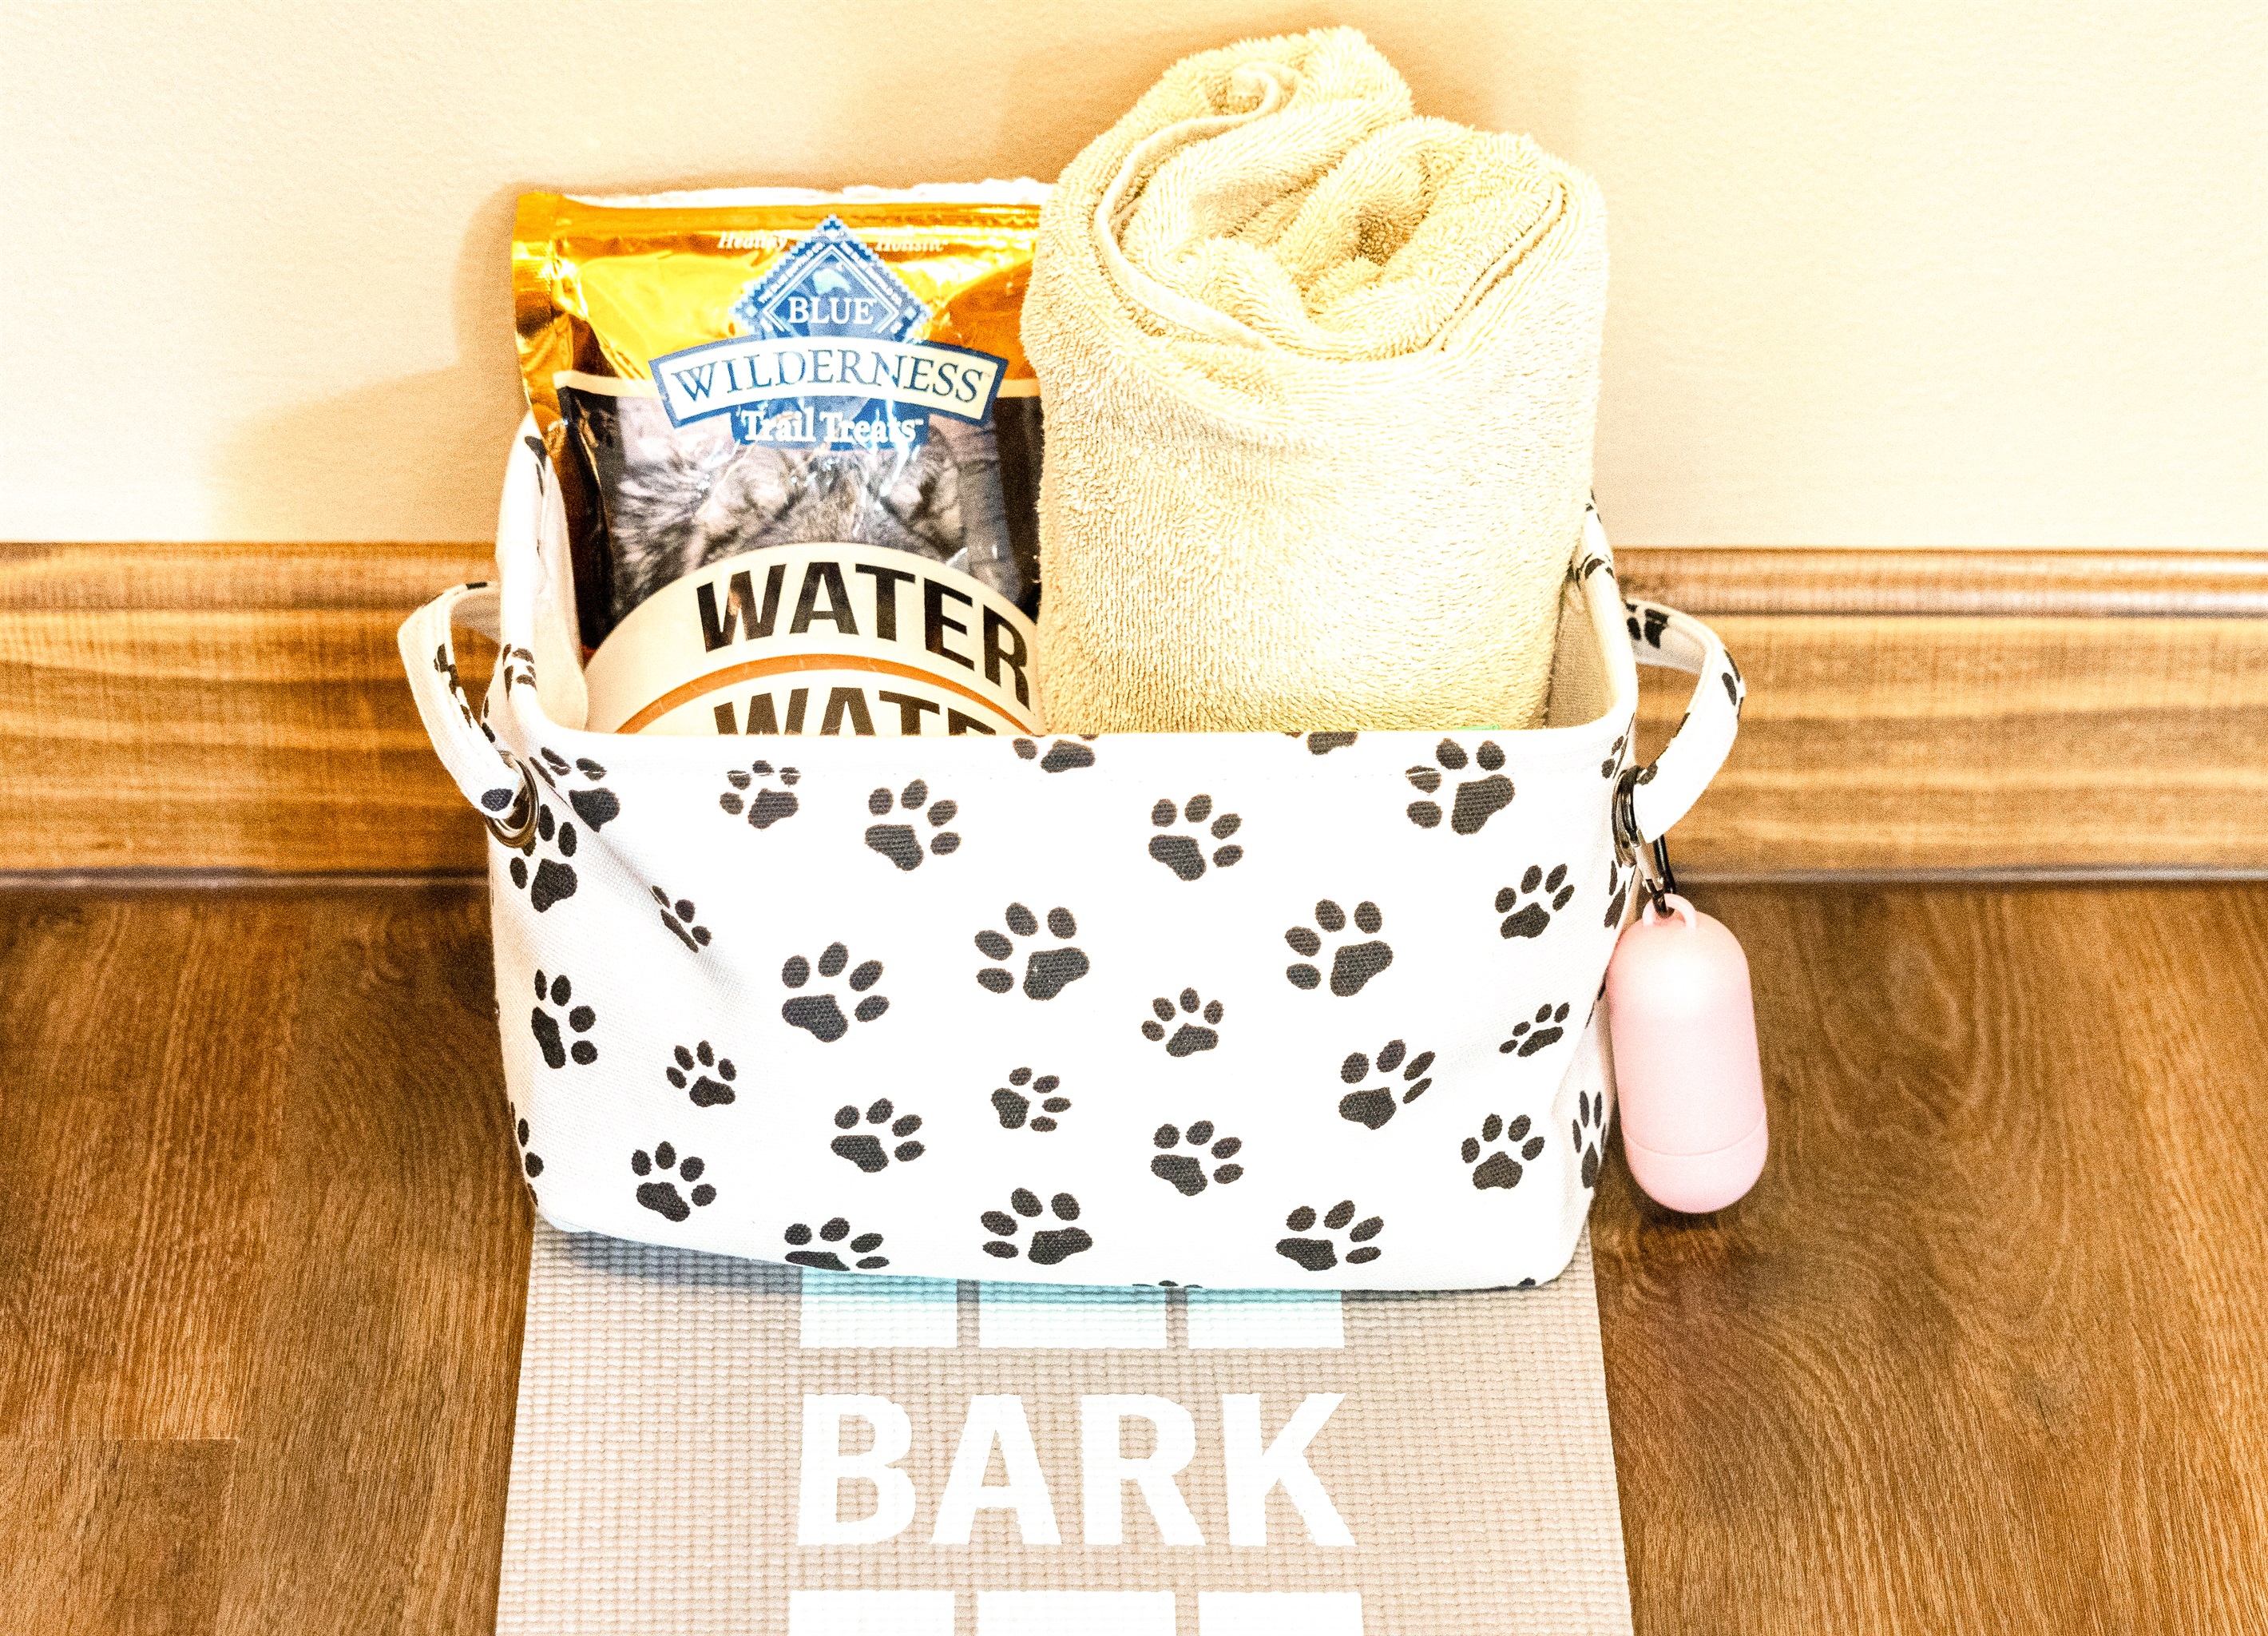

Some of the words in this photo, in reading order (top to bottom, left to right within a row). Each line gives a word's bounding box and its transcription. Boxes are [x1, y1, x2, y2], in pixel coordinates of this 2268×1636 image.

[787, 296, 877, 324] BLUE
[670, 349, 985, 403] WILDERNESS
[740, 406, 816, 442] Trail
[819, 411, 917, 443] Treats
[696, 562, 1031, 713] WATER
[797, 1392, 1357, 1547] BARK
